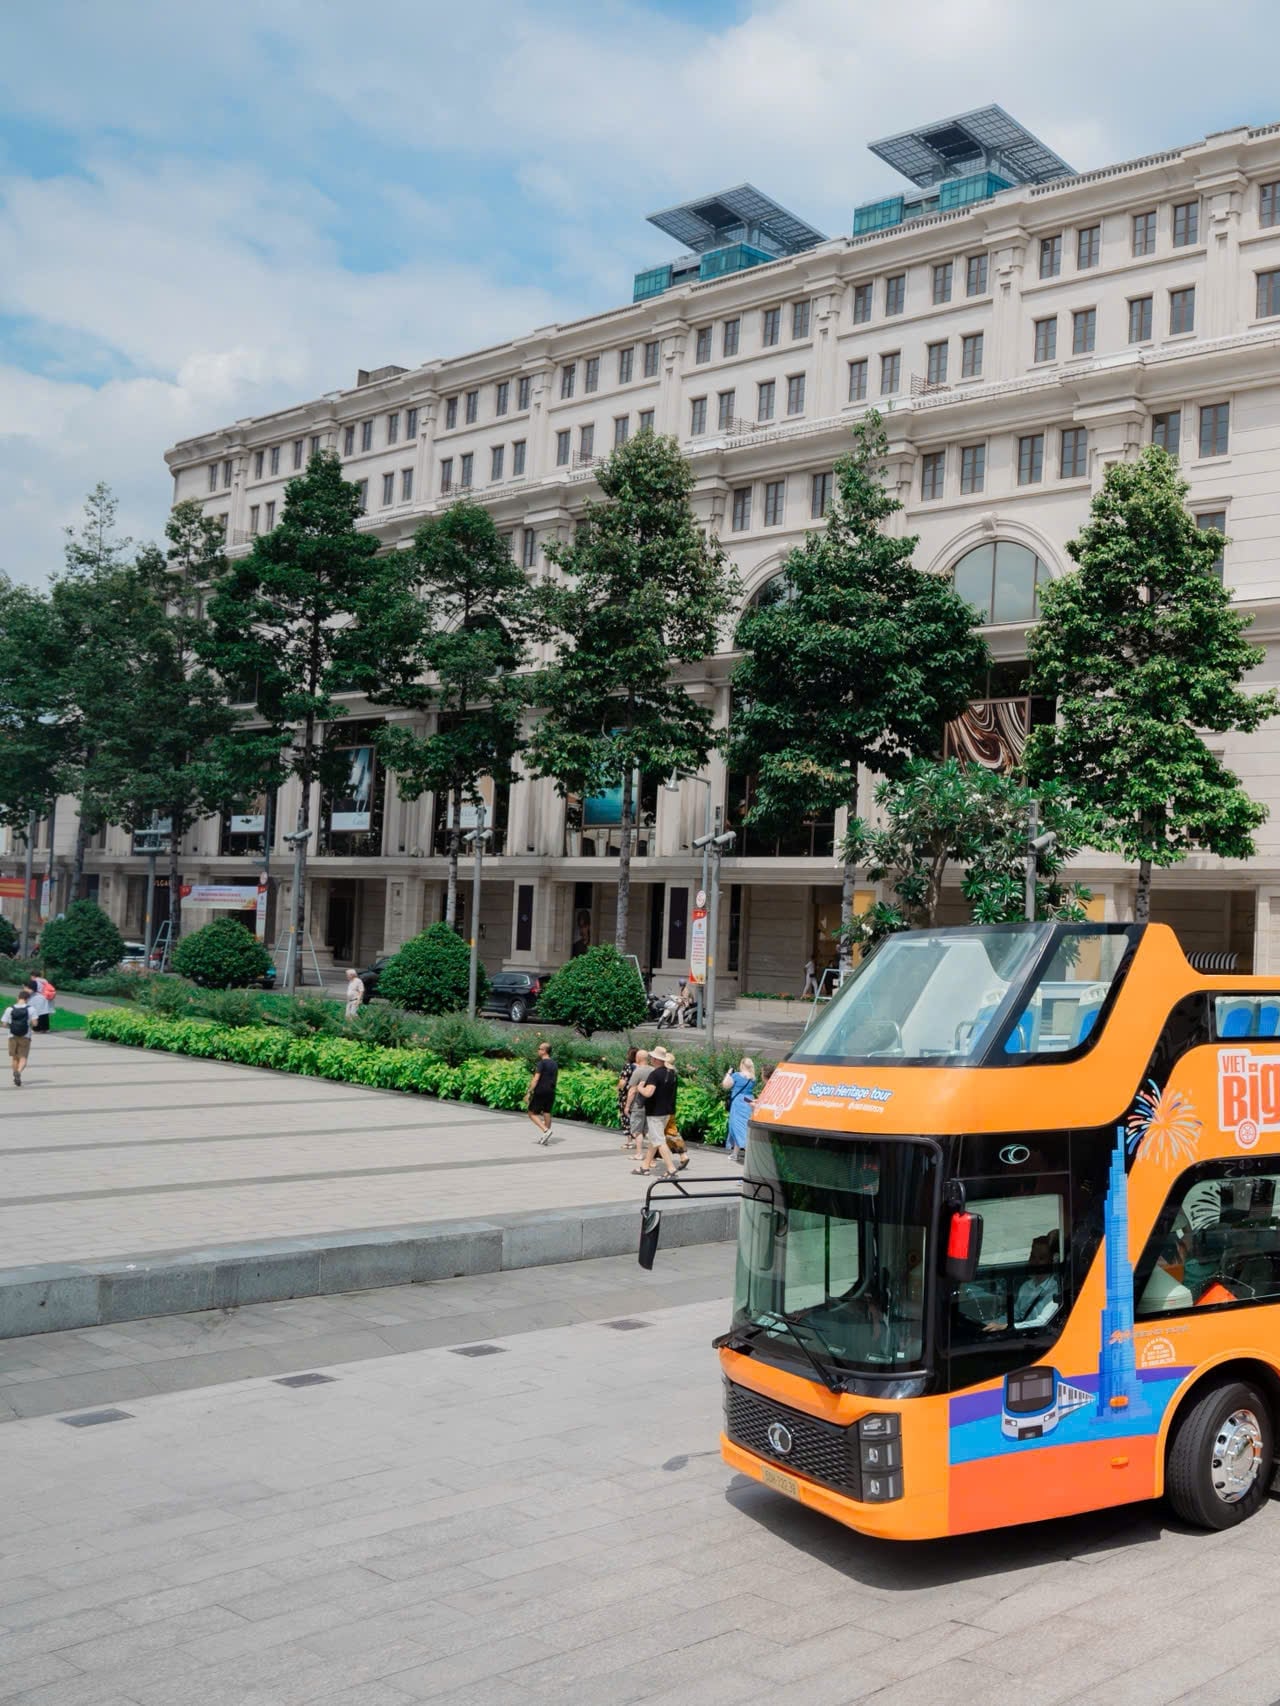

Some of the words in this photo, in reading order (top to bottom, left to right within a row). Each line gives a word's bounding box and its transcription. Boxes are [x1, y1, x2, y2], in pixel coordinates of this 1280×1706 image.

[1222, 1055, 1246, 1073] VIET
[808, 1082, 834, 1098] Saigon
[835, 1084, 869, 1101] Heritage
[870, 1087, 893, 1102] tour
